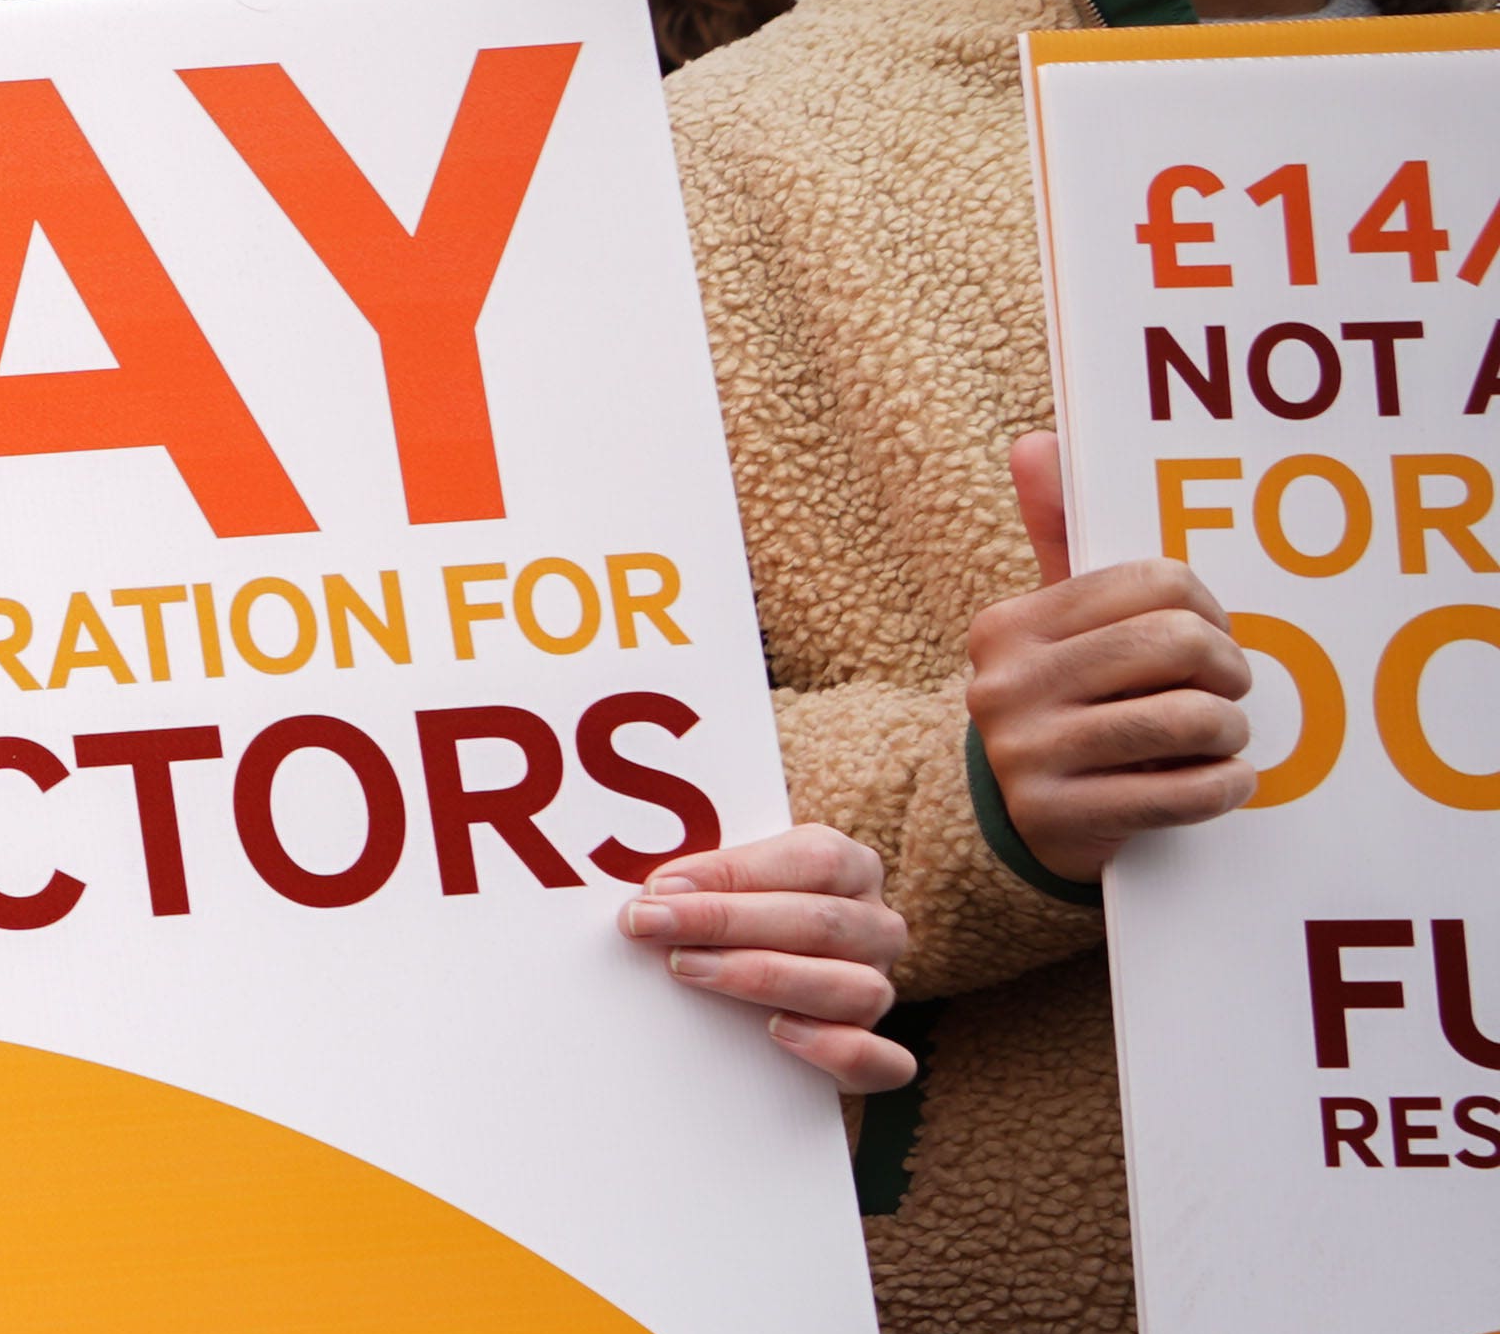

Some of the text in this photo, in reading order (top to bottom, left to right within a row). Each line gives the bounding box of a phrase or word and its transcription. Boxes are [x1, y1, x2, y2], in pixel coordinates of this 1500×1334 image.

[1143, 319, 1424, 421] NOT
[1154, 453, 1500, 578] FOR
[442, 552, 692, 661] FOR
